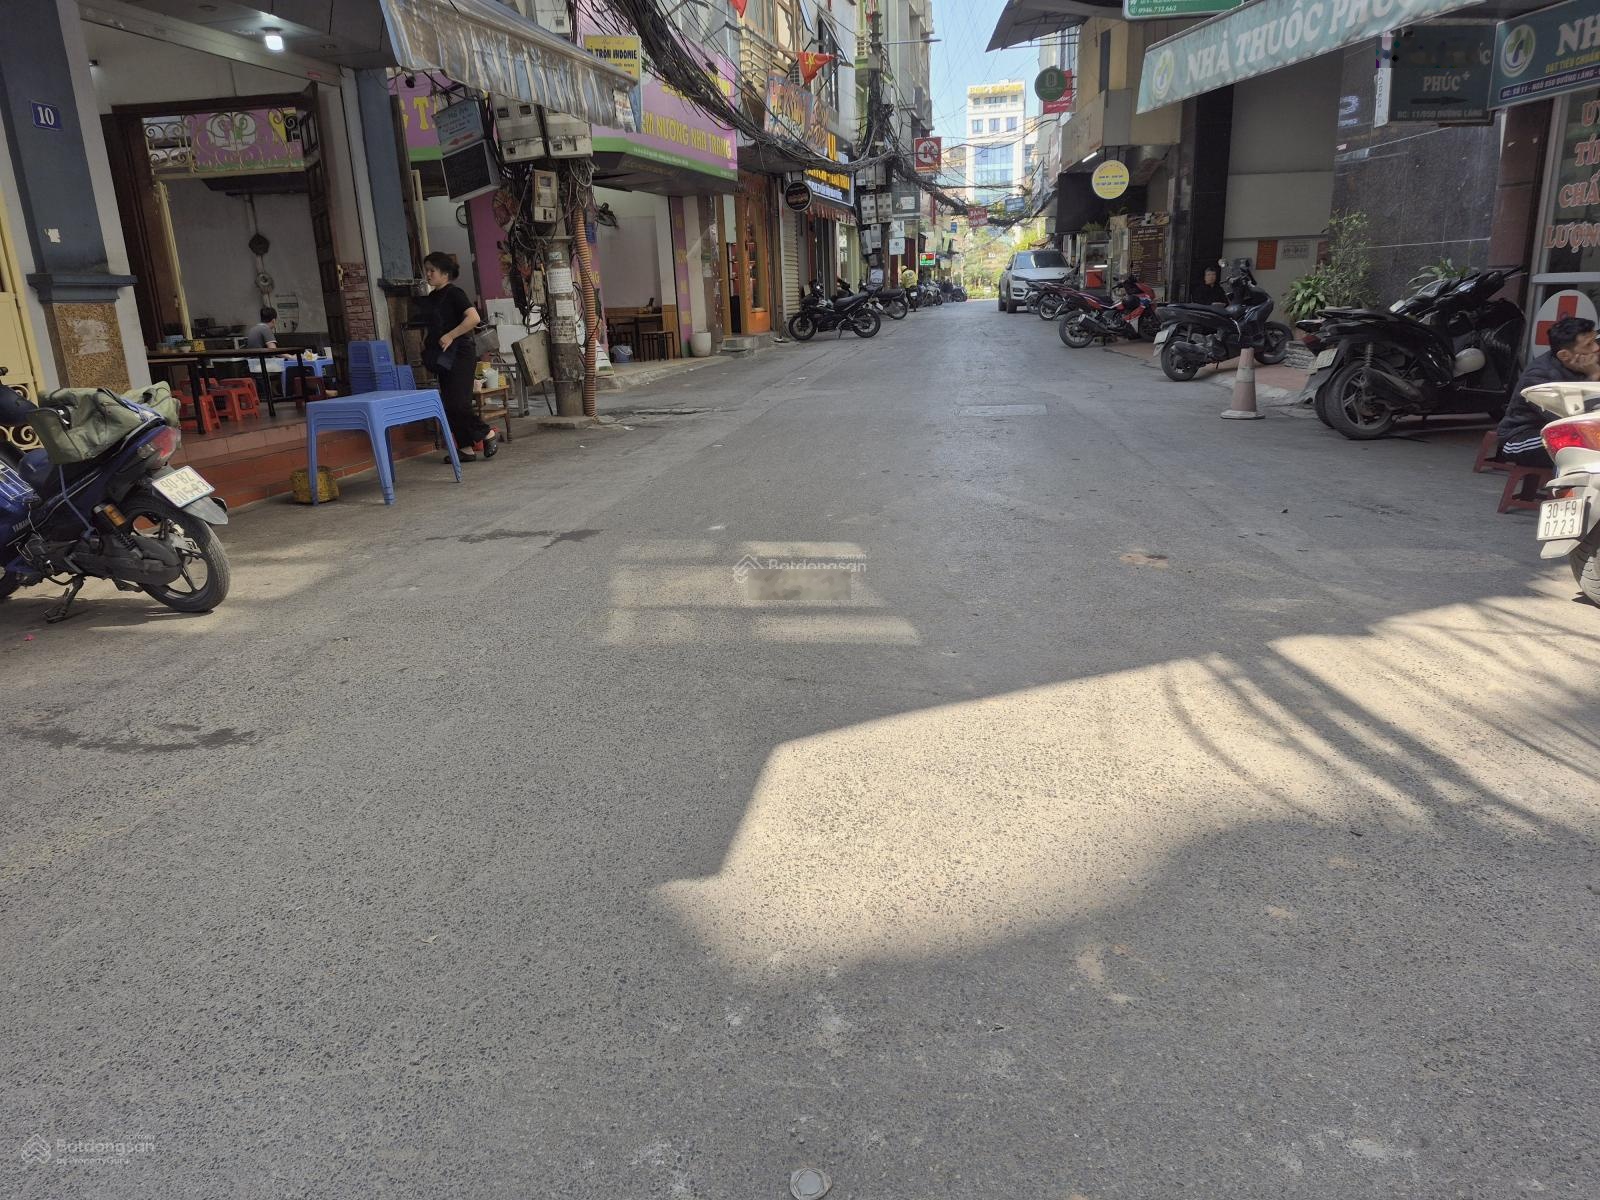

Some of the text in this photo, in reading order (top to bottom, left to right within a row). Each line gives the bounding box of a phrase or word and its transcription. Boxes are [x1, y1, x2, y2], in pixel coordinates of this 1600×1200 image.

[37, 105, 55, 126] 10
[1546, 500, 1578, 519] 30-F9
[1544, 518, 1575, 537] 0723
